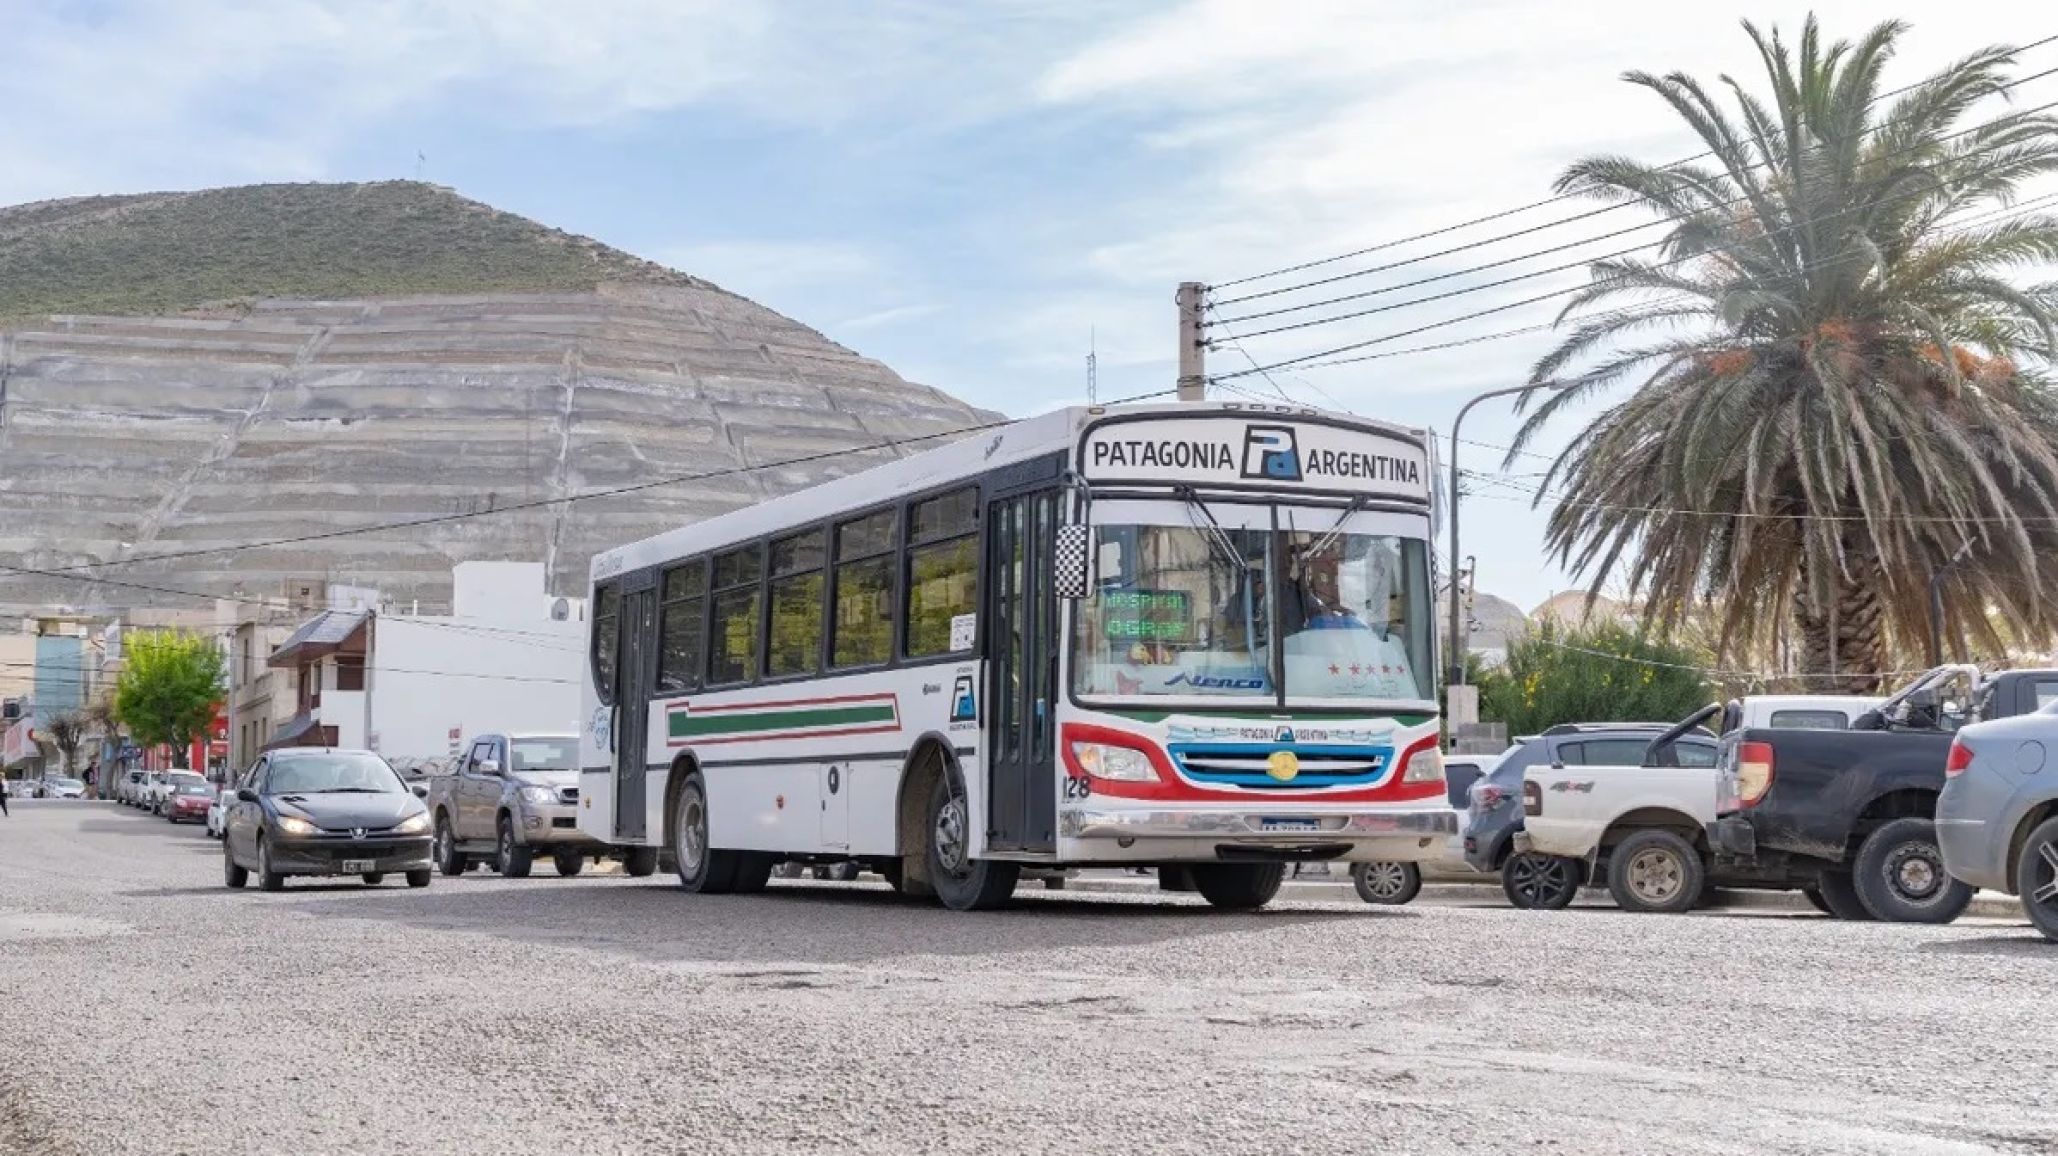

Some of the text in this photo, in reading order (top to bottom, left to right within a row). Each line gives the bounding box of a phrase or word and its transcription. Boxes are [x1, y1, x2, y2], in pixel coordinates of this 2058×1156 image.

[1093, 440, 1235, 471] PATAGONIA
[1305, 449, 1421, 485] ARGENTINA
[1062, 775, 1091, 799] 128
